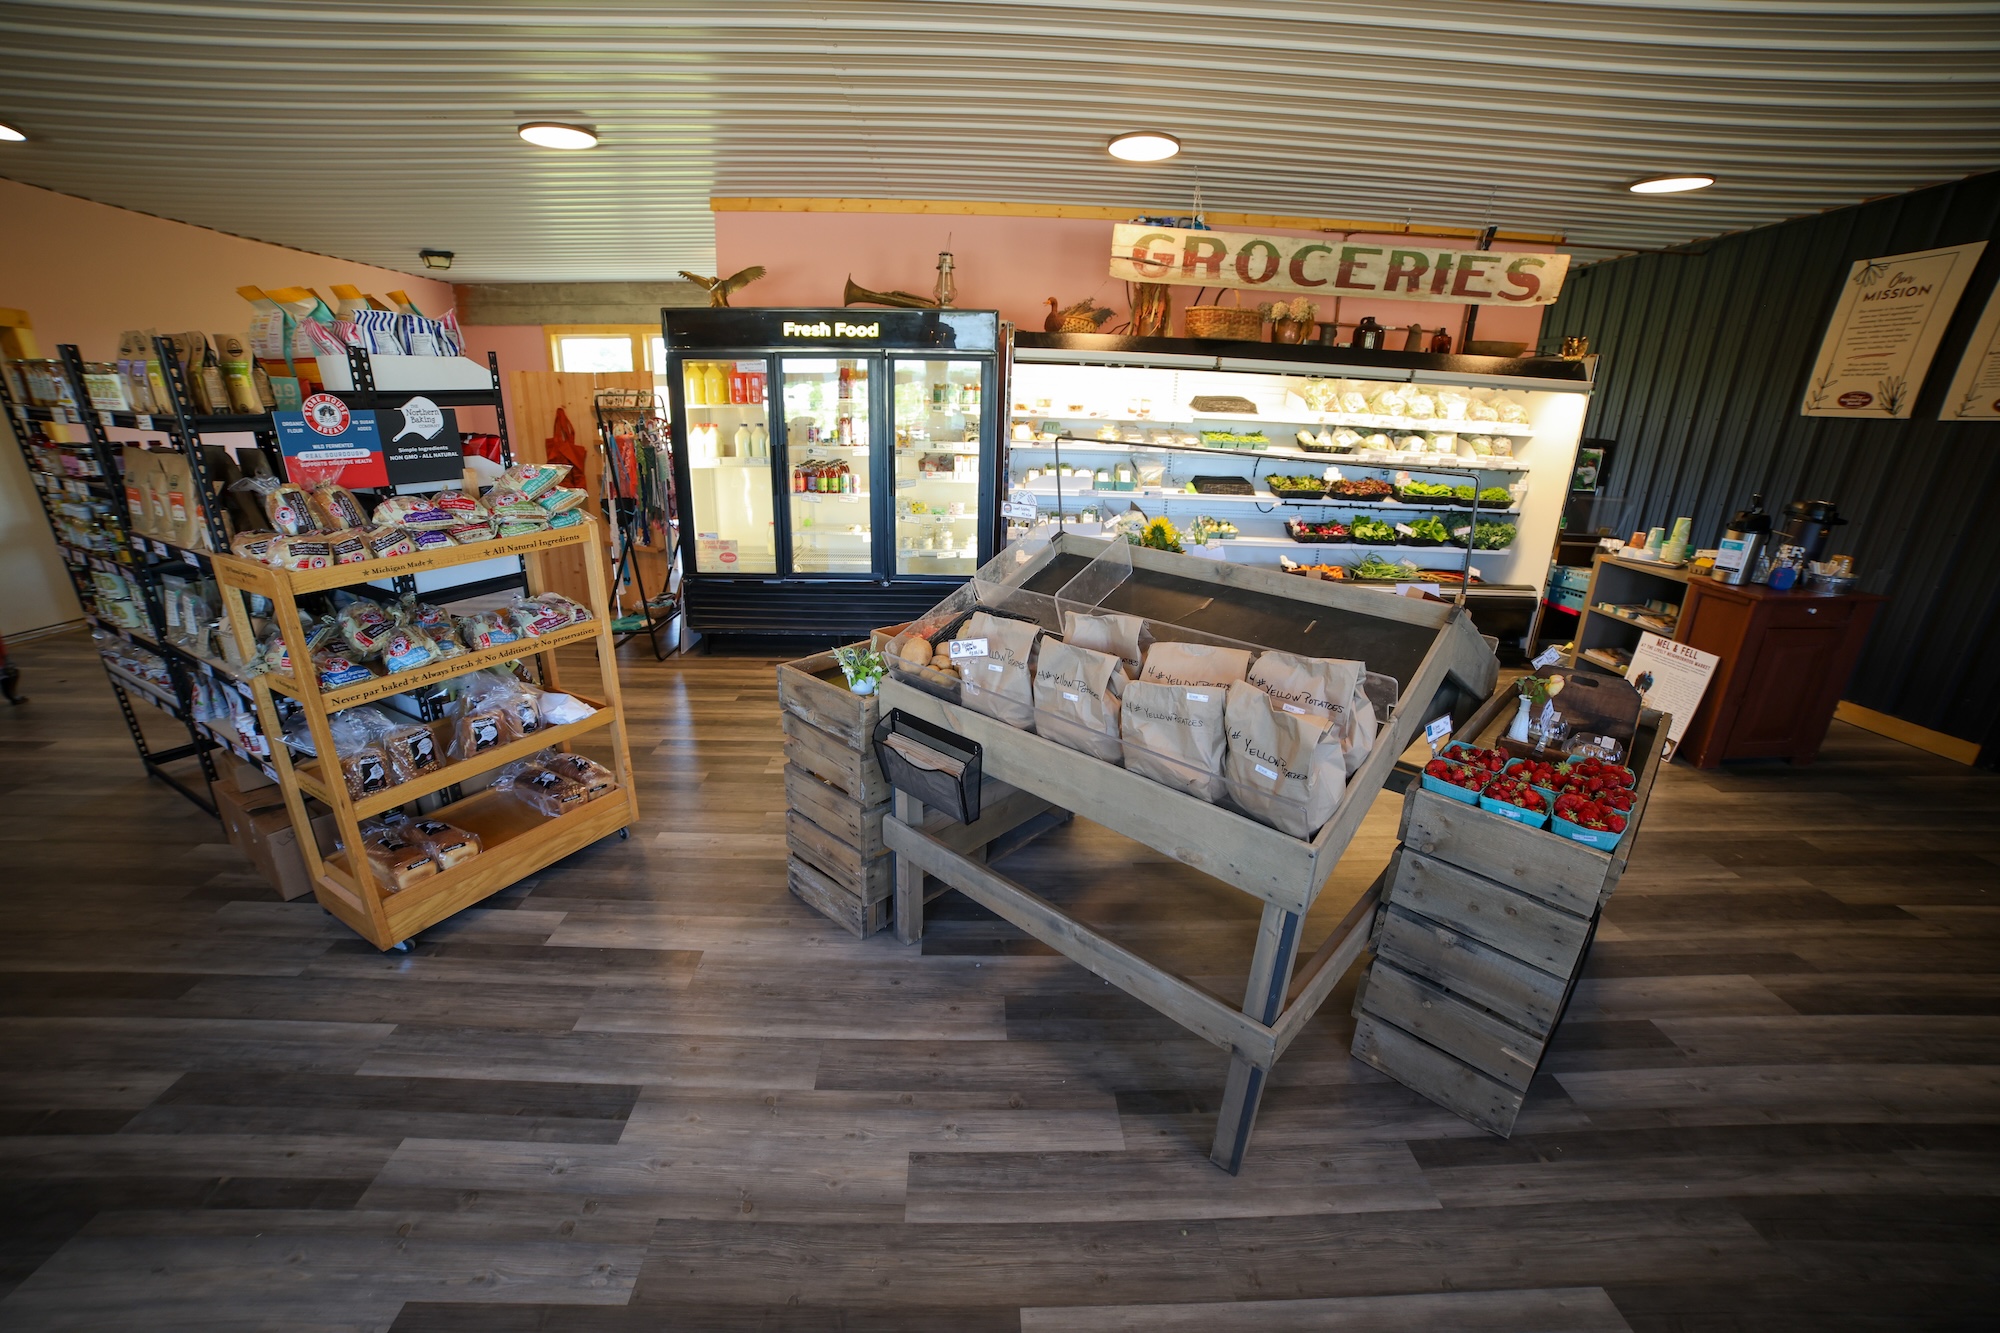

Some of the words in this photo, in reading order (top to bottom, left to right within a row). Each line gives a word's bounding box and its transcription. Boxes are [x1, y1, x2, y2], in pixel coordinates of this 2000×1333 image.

[1132, 233, 1546, 302] GROCERIES
[1888, 271, 1916, 288] Our
[1863, 284, 1933, 302] MISSION
[783, 321, 831, 337] Fresh
[834, 322, 879, 338] Food
[304, 394, 322, 416] STONE
[324, 394, 348, 416] HOUSE
[405, 408, 440, 417] Northern
[410, 416, 436, 424] Baking
[317, 424, 344, 435] BREAD
[324, 450, 364, 458] SOURDOUGH
[300, 460, 328, 468] SUPPORTS
[372, 564, 406, 575] Michigan
[406, 560, 426, 569] Made
[492, 547, 504, 556] All
[507, 542, 536, 554] Natural
[538, 534, 580, 548] Ingredients
[1656, 638, 1670, 650] MEL
[1672, 644, 1678, 653] &
[1680, 646, 1698, 660] FELL
[332, 693, 361, 706] Never
[363, 689, 380, 700] par
[382, 678, 409, 692] baked
[421, 668, 449, 682] Always
[450, 661, 474, 672] Fresh
[485, 654, 497, 663] No
[499, 644, 532, 659] Additives
[541, 638, 552, 647] No
[554, 627, 595, 646] preservatives
[1694, 661, 1711, 671] MARKET
[1266, 684, 1302, 702] YELLOW
[1302, 692, 1344, 714] POTATOES
